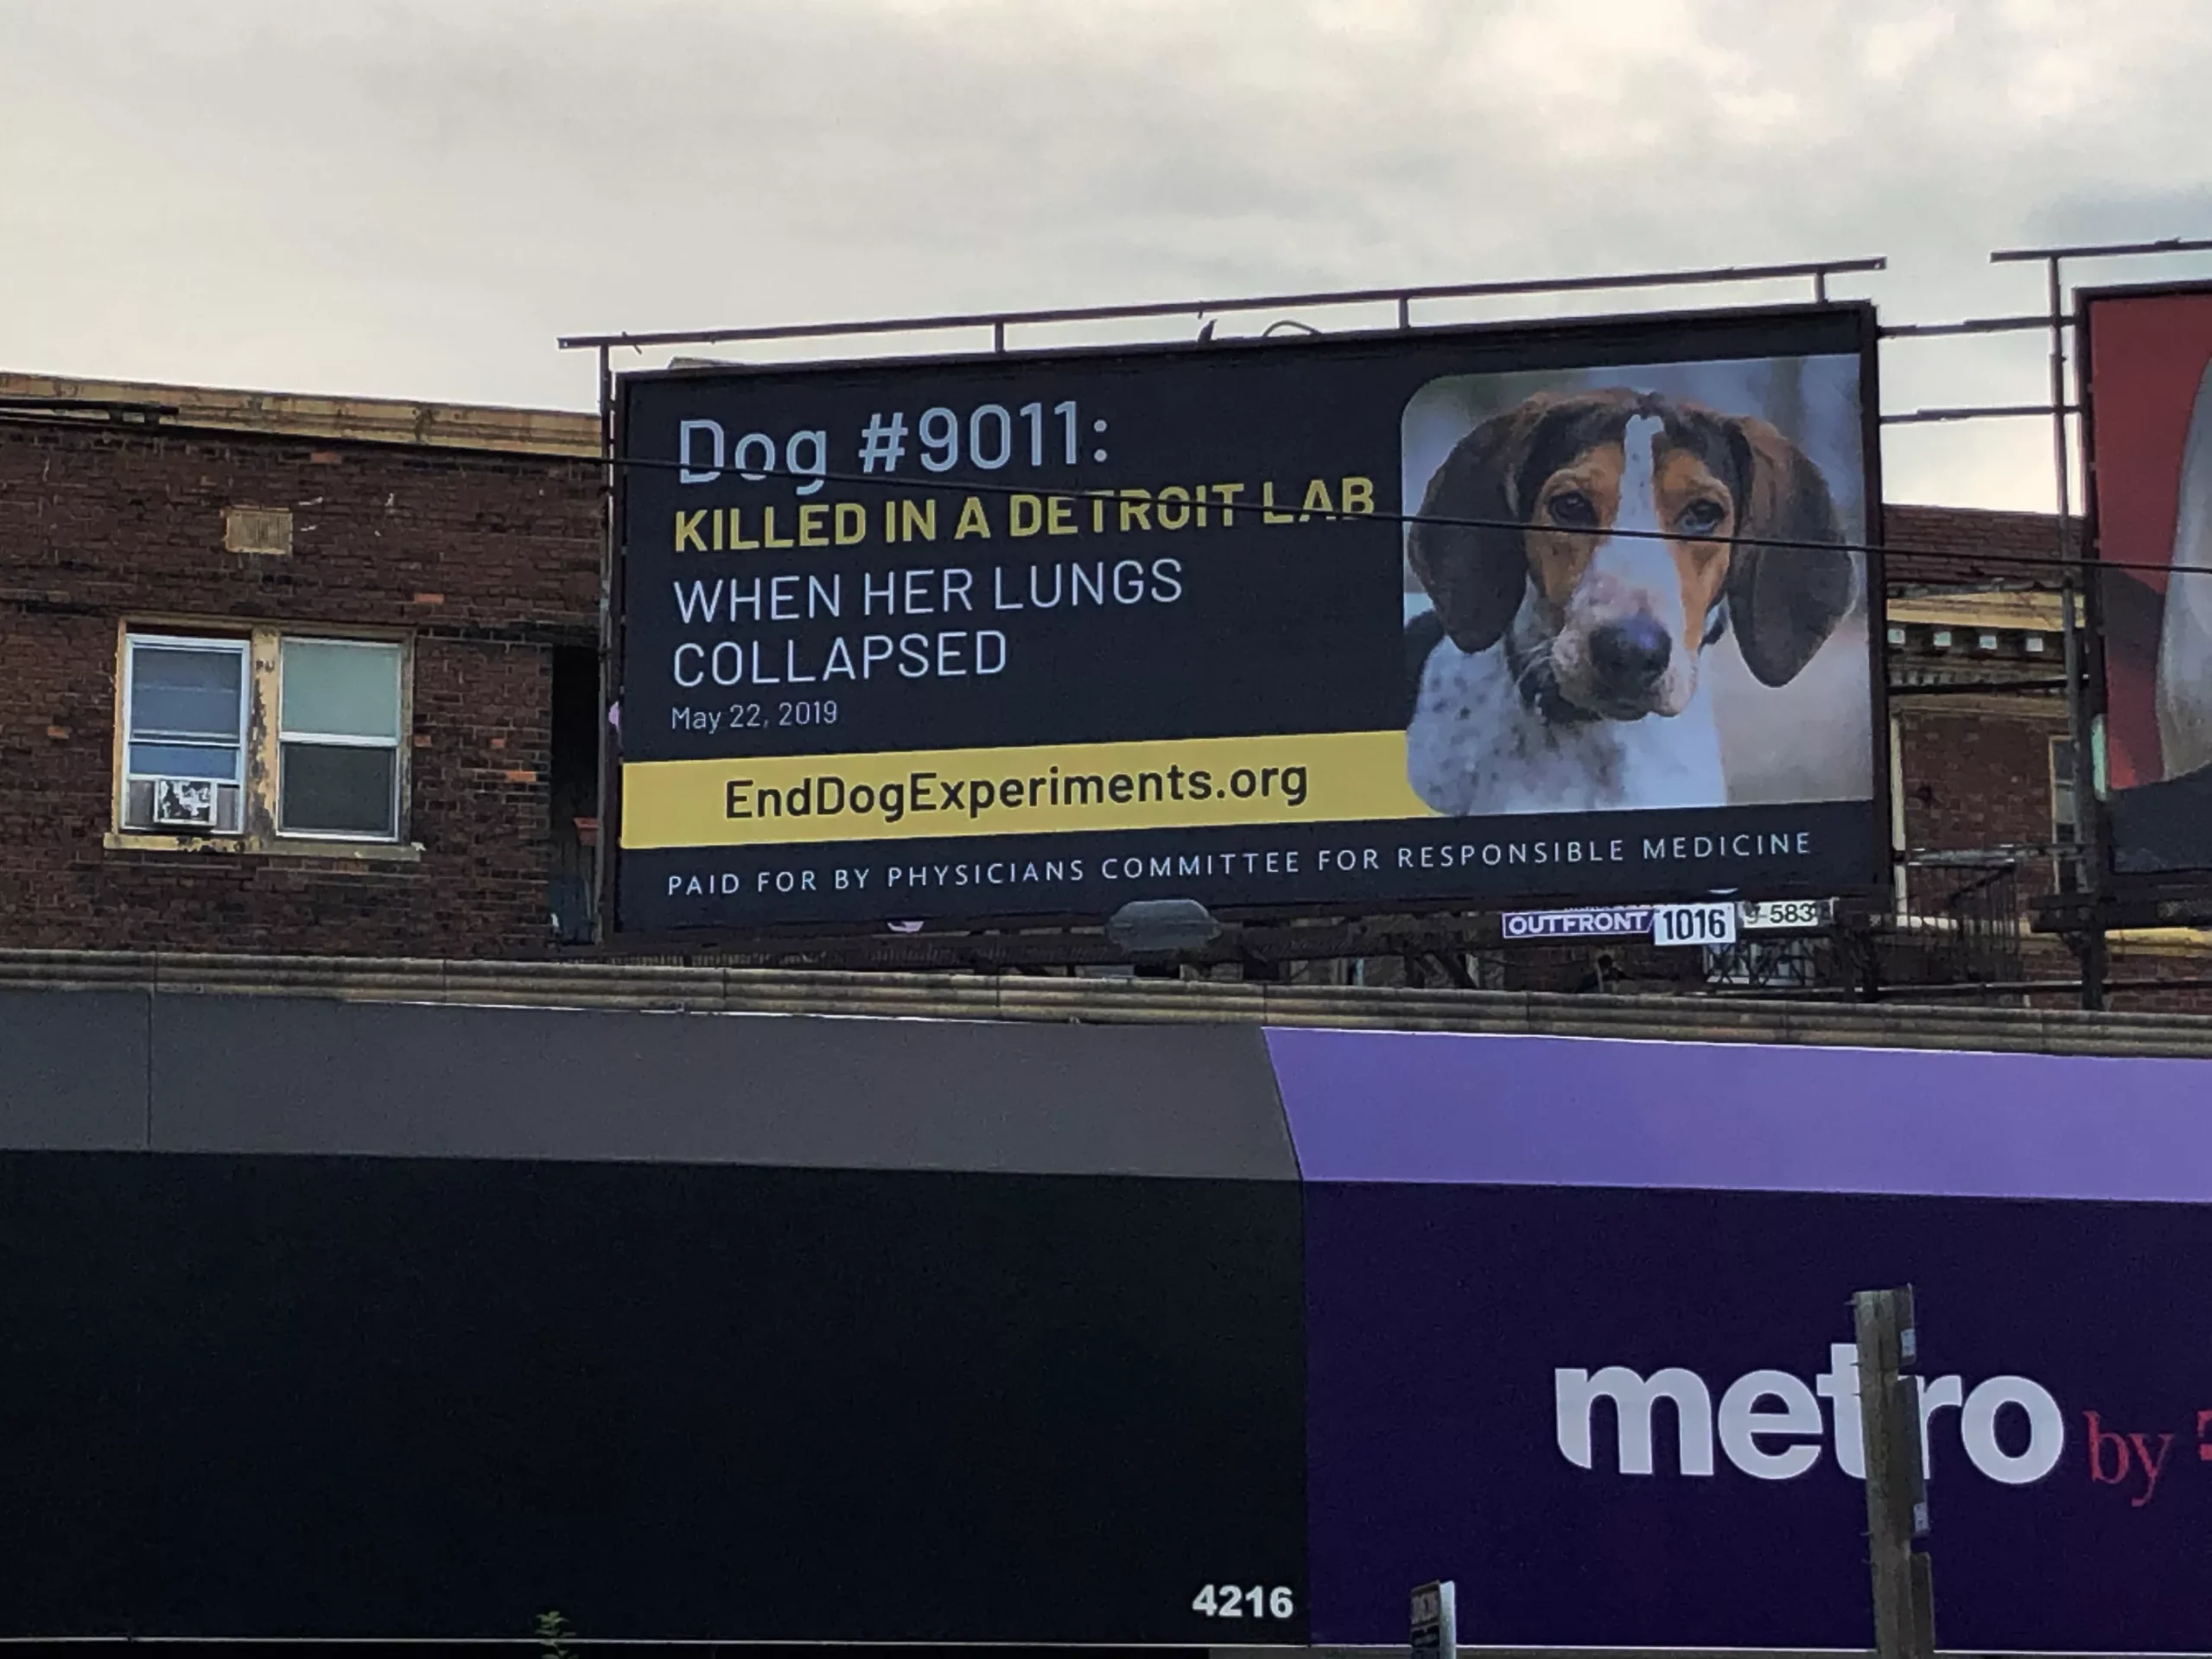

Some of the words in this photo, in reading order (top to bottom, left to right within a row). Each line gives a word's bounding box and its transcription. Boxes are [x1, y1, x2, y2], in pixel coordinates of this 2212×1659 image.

[679, 419, 827, 496] Dog
[858, 400, 1108, 474] #9011:
[675, 503, 866, 552] KILLED
[886, 499, 936, 543] IN
[954, 496, 991, 540] A
[1010, 483, 1244, 537] DETROIT
[1263, 476, 1375, 524] LAB
[674, 574, 840, 624] WHEN
[864, 569, 973, 615] HER
[995, 558, 1182, 610] LUNGS
[674, 630, 1006, 687] COLLAPSED
[671, 707, 721, 734] May
[729, 703, 768, 730] 22,
[779, 700, 837, 726] 2019
[726, 764, 1308, 823] EndDogExperiments.org
[668, 874, 740, 895] PAID
[758, 870, 817, 893] FOR
[835, 868, 869, 889] BY
[888, 860, 1084, 887] PHYSICIANS
[1102, 851, 1299, 880] COMMITTEE
[1319, 849, 1379, 871] FOR
[1398, 839, 1623, 868] RESPONSIBLE
[1643, 832, 1811, 859] MEDICINE
[1508, 912, 1648, 935] OUTFRONT
[1662, 909, 1726, 940] 1016
[2082, 1410, 2175, 1507] by
[1192, 1584, 1294, 1618] 4216
